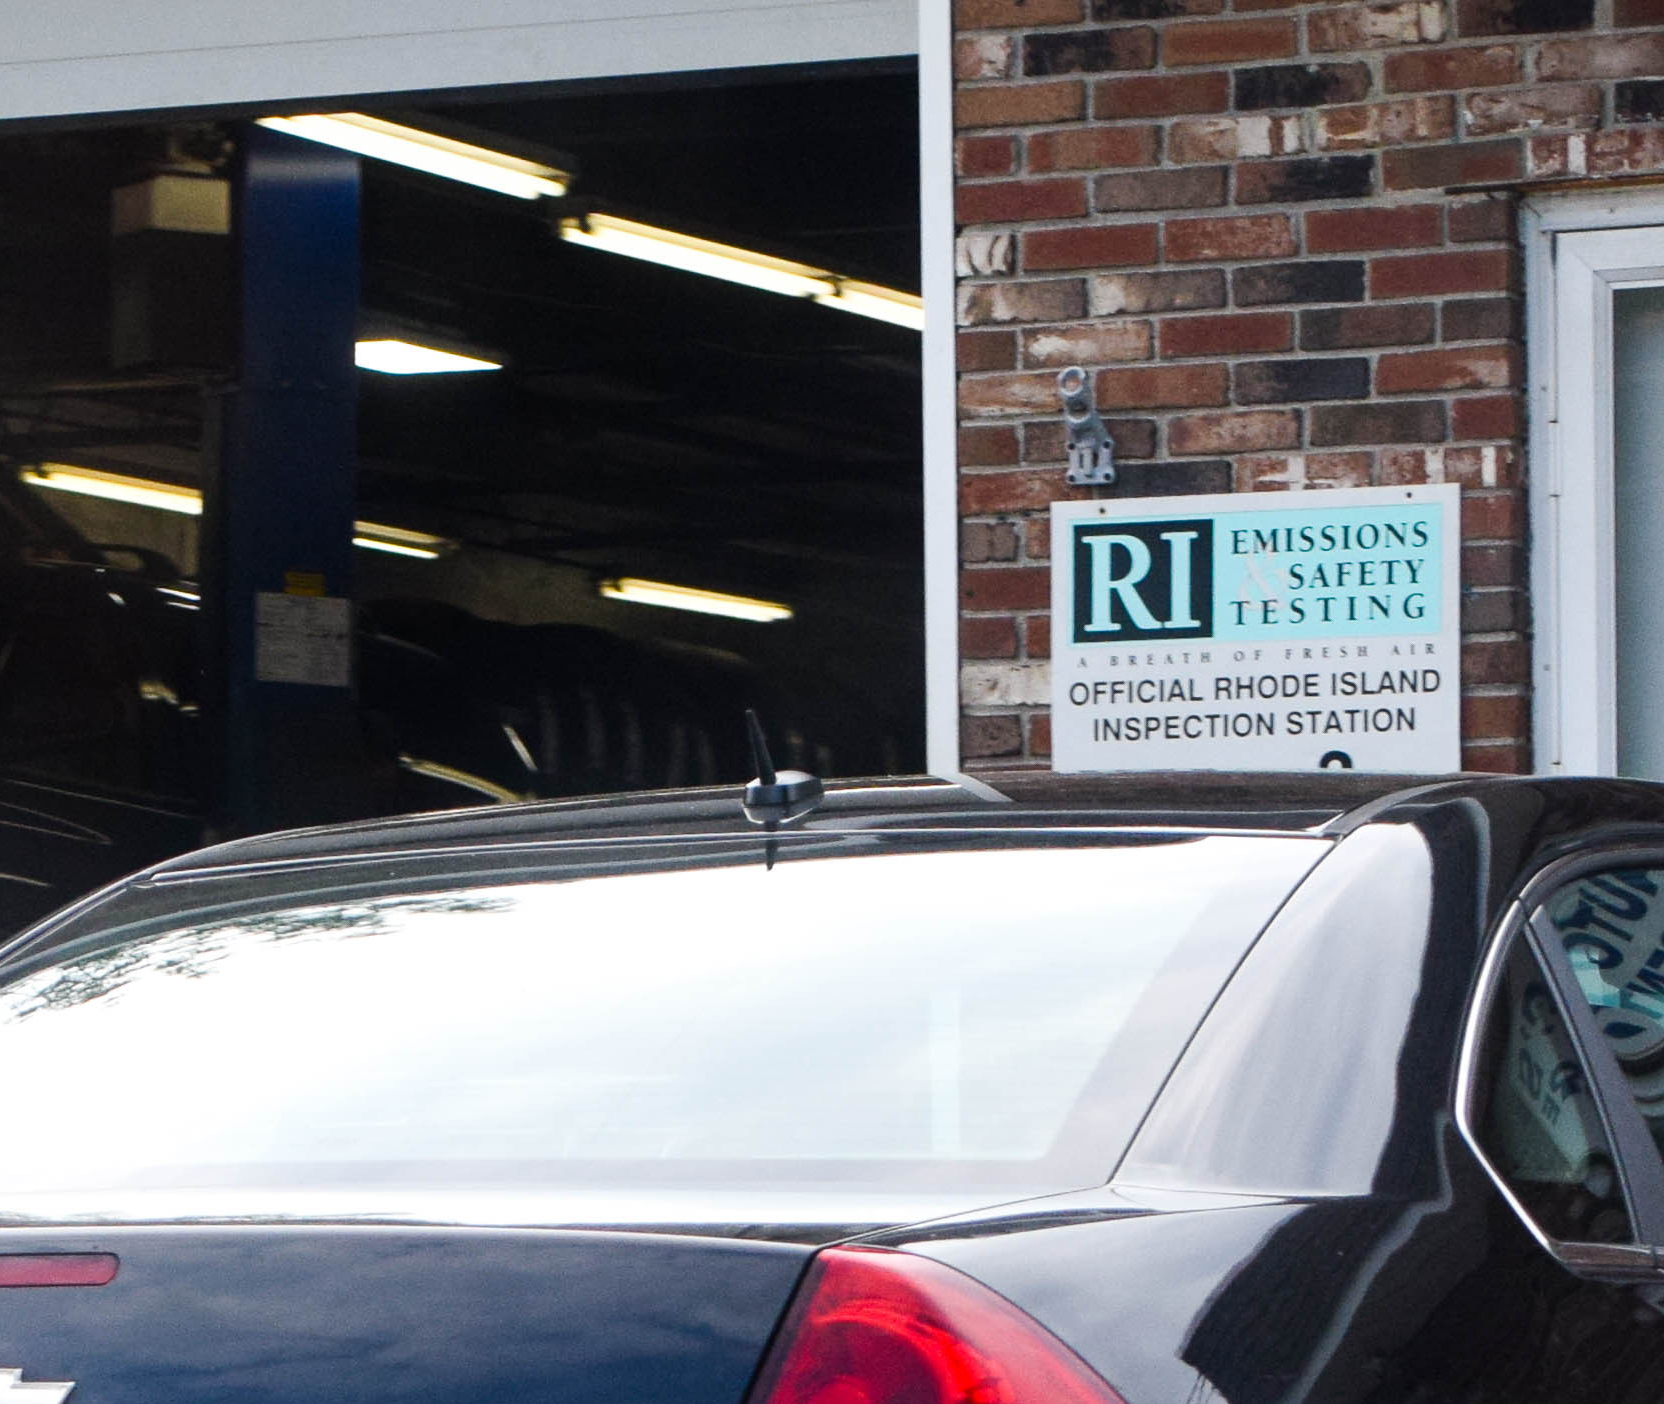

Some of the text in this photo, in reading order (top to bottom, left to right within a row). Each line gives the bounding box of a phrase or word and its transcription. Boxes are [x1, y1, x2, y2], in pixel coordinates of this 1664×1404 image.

[1230, 520, 1429, 555] EMISSIONS
[1081, 530, 1202, 633] RI
[1288, 558, 1425, 590] SAFETY
[1229, 592, 1426, 626] TESTING
[1077, 642, 1436, 668] A BREATH OF FRESH AIR
[1069, 668, 1441, 707] OFFICIAL RHODE ISLAND
[1093, 707, 1416, 742] INSPECTION STATION
